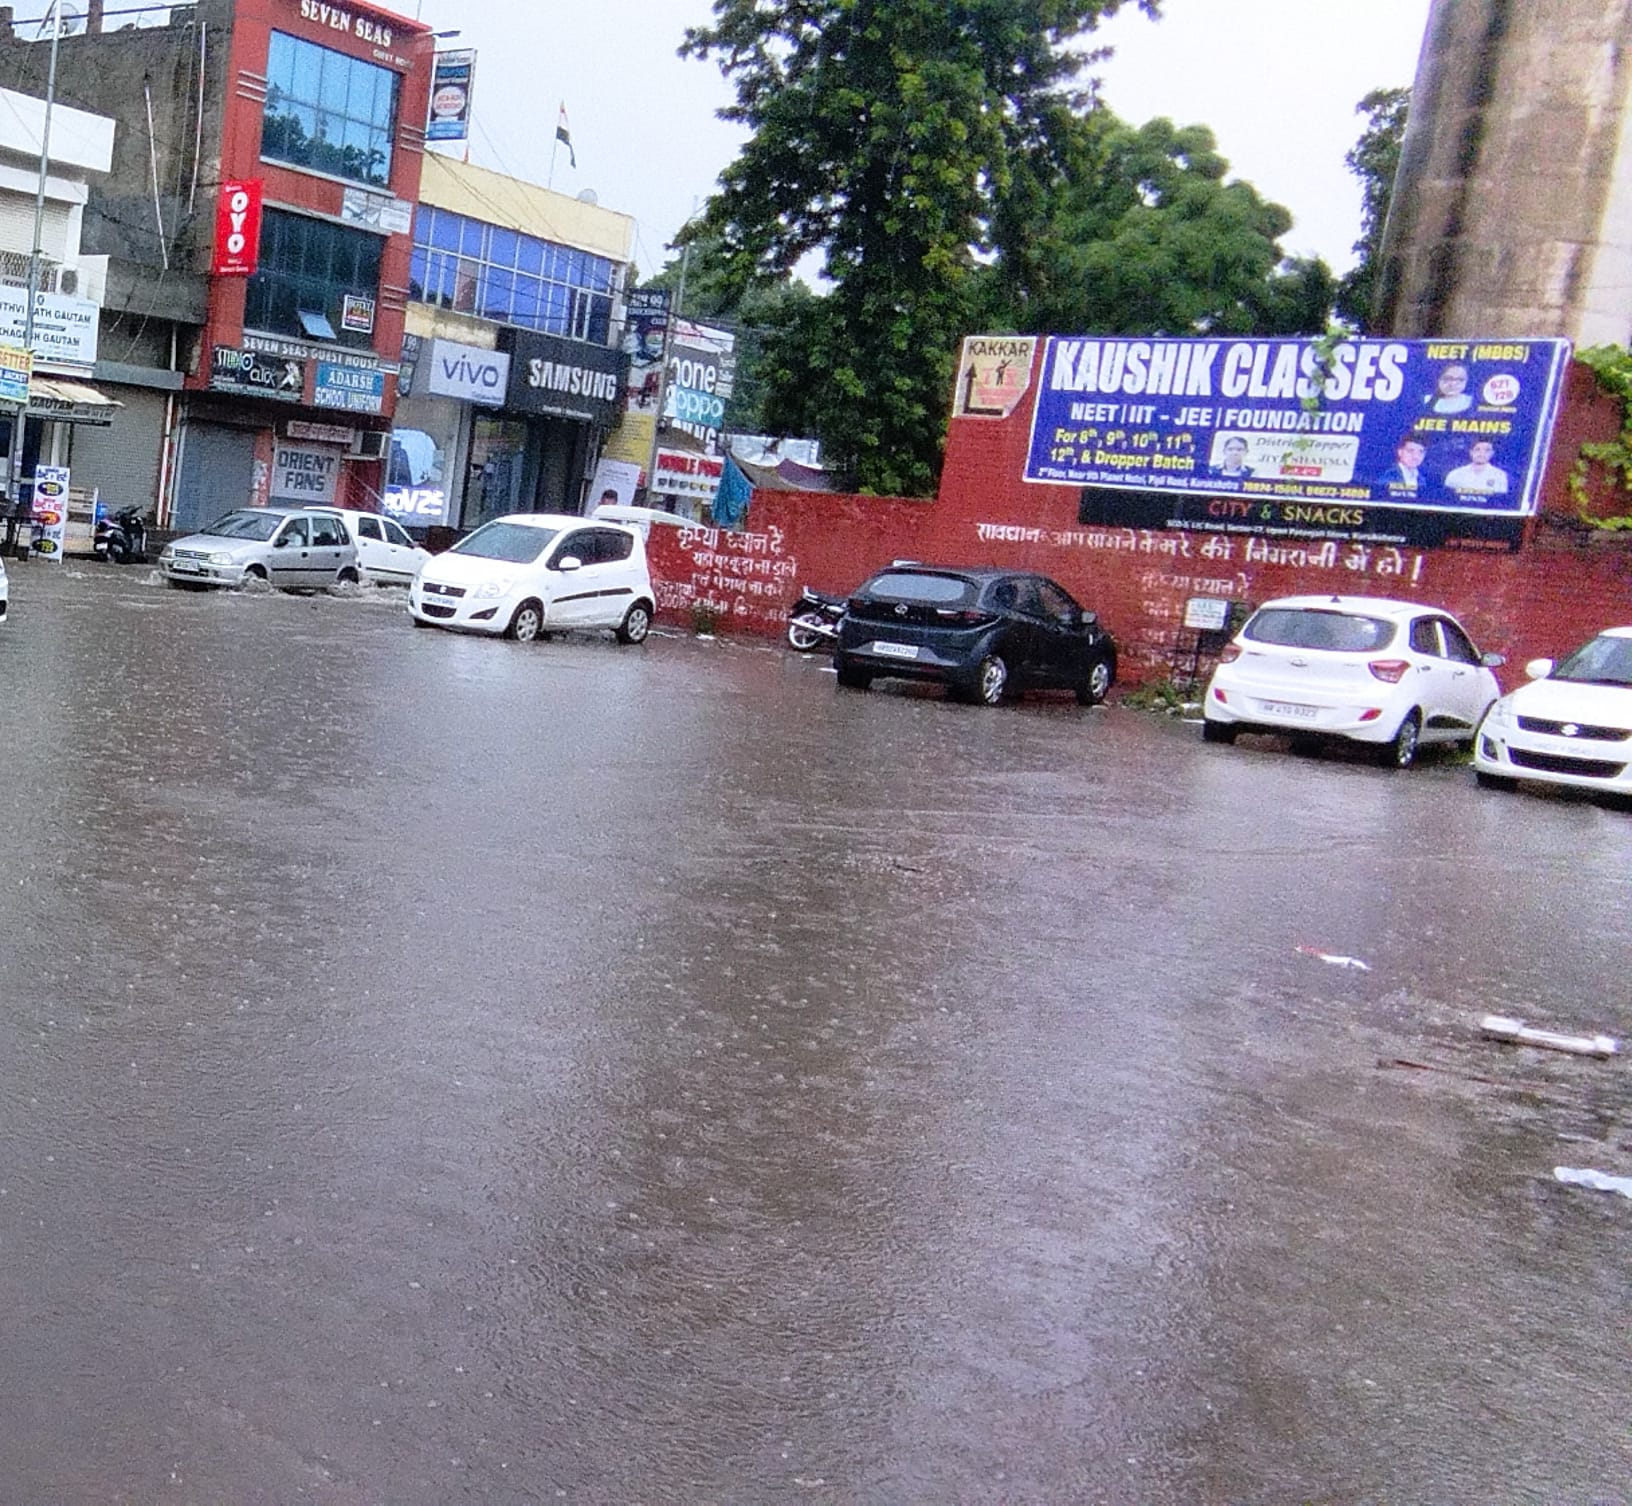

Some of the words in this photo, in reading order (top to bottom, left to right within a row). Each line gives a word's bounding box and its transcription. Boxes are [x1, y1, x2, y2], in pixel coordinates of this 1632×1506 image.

[300, 0, 352, 32] SEVEN
[354, 18, 393, 47] SEAS
[227, 191, 248, 254] OYO
[34, 307, 53, 318] ATH
[54, 310, 91, 323] GAUTAM
[43, 334, 81, 347] GAUTAM
[968, 341, 1029, 357] KAKKAR
[243, 336, 281, 355] SEVEN
[282, 343, 308, 358] SEAS
[311, 347, 343, 364] GUEST
[345, 353, 378, 370] HOUSE
[1426, 344, 1469, 359] NEET
[1472, 344, 1530, 363] (MBBS)
[327, 371, 374, 390] ADARSH
[442, 354, 500, 388] vivo
[529, 358, 618, 401] SAMSUNG
[1050, 340, 1220, 398] KAUSHIK
[1221, 342, 1408, 401] CLASSES
[676, 390, 724, 421] oppo
[1070, 402, 1119, 422] NEET
[1129, 405, 1156, 424] IIT
[1174, 408, 1211, 427] JEE
[1224, 408, 1364, 433] FOUNDATION
[1055, 428, 1077, 443] For
[1414, 418, 1448, 431] JEE
[1451, 419, 1512, 434] MAINS
[277, 450, 335, 474] ORIENT
[1081, 450, 1091, 465] &
[1094, 450, 1151, 470] Dropper
[1152, 454, 1195, 471] Batch
[284, 471, 326, 492] FANS
[1208, 500, 1253, 517] CITY
[1260, 503, 1272, 519] &
[1282, 505, 1364, 525] SNACKS
